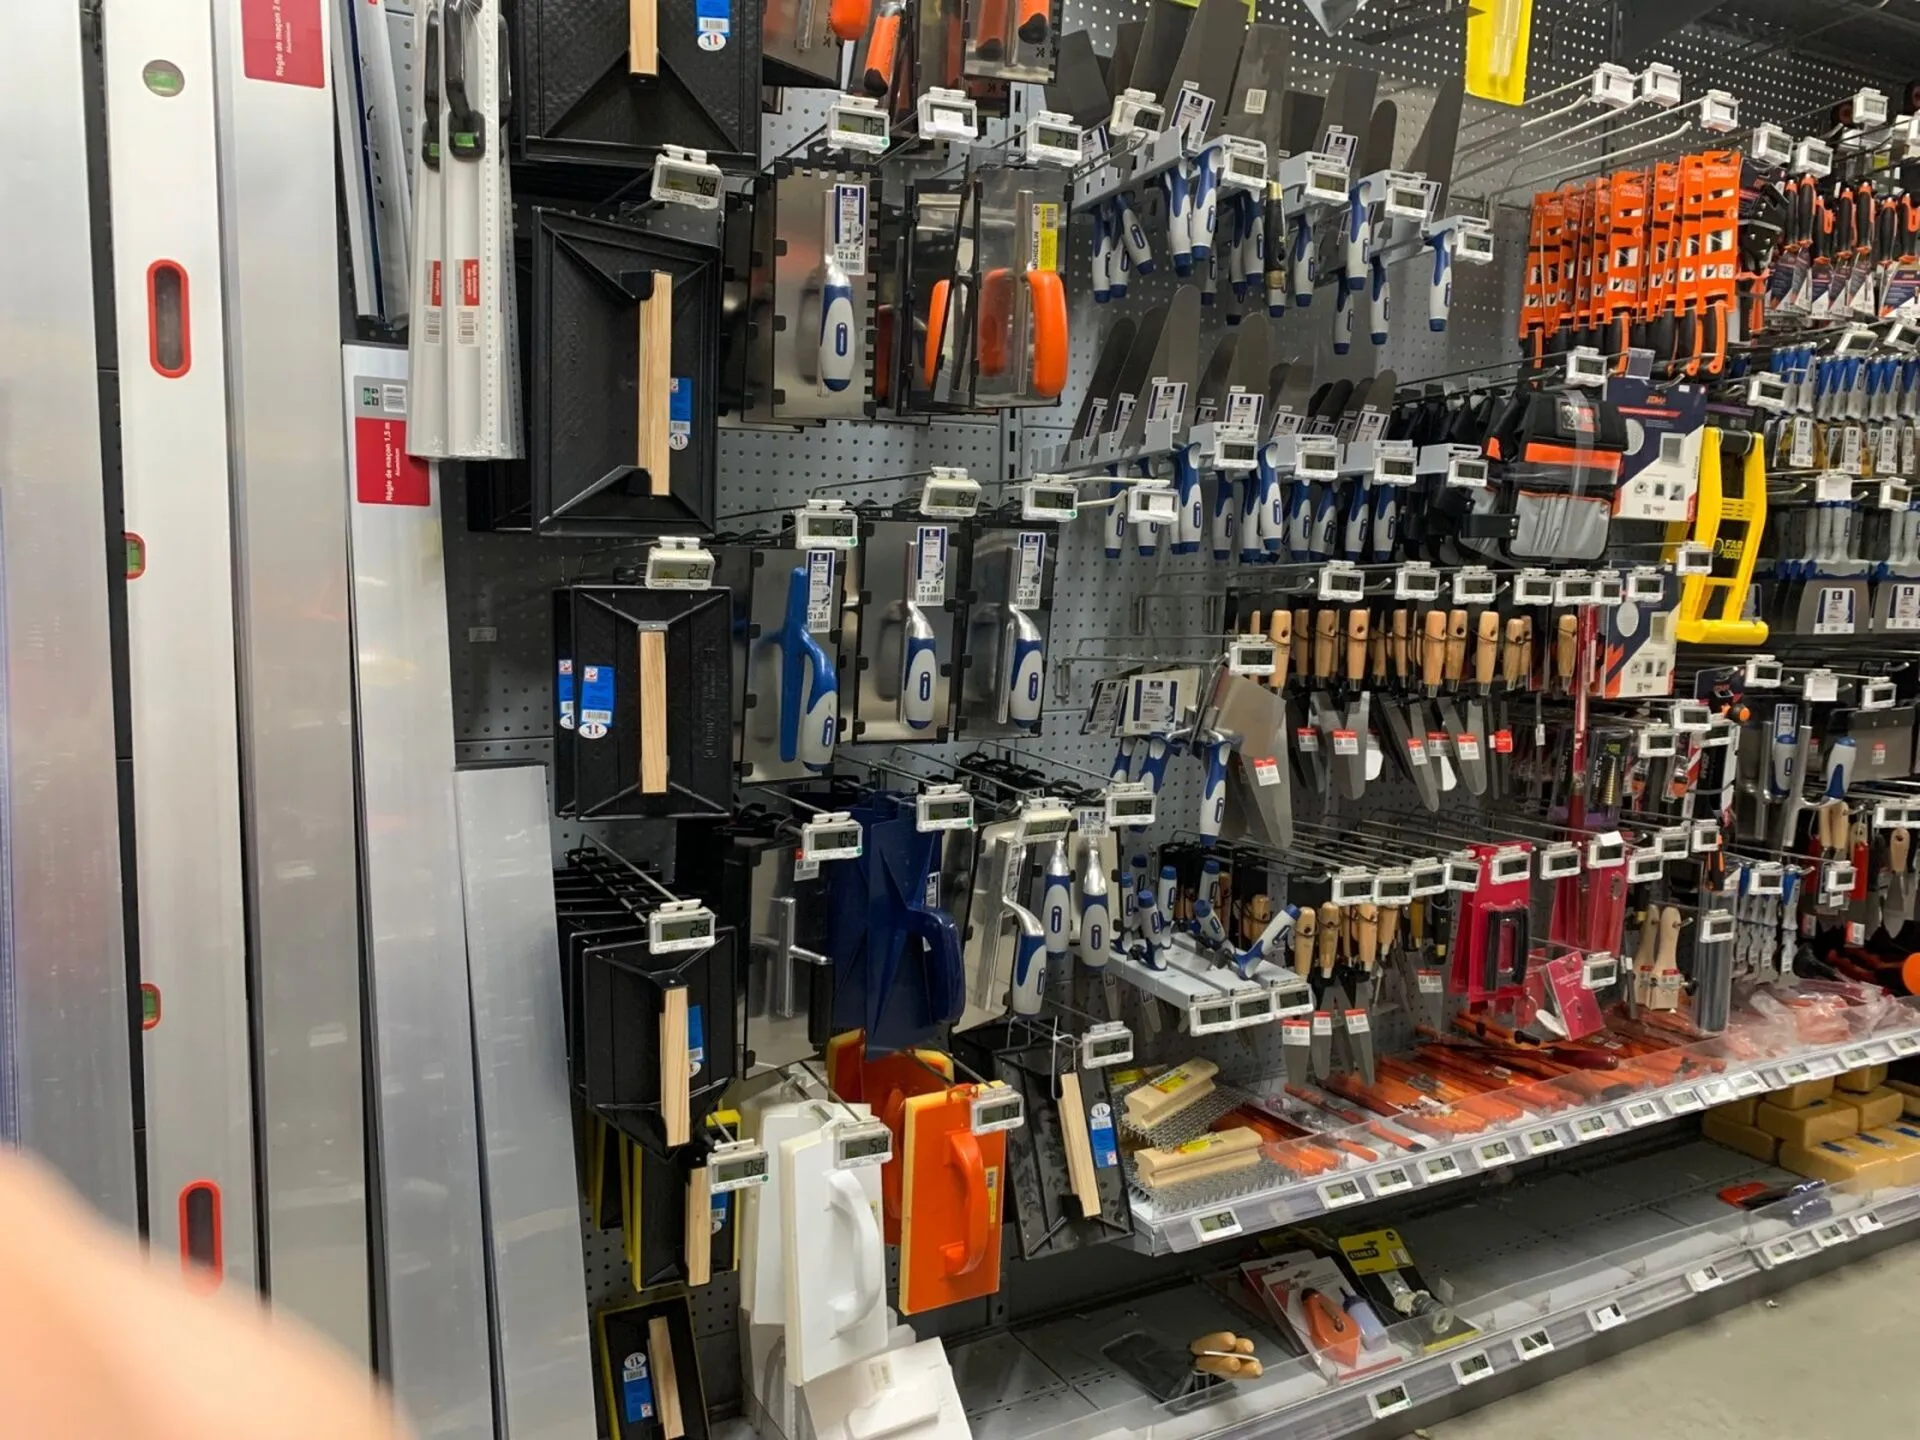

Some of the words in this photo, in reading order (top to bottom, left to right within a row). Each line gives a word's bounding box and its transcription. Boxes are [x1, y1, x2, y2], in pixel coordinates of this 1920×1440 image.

[275, 12, 284, 40] maçon
[275, 41, 283, 52] de
[275, 53, 285, 76] Règle
[384, 421, 391, 430] m
[383, 431, 392, 441] 1,5
[384, 442, 393, 469] maçon
[384, 470, 392, 480] de
[384, 481, 394, 502] Règle
